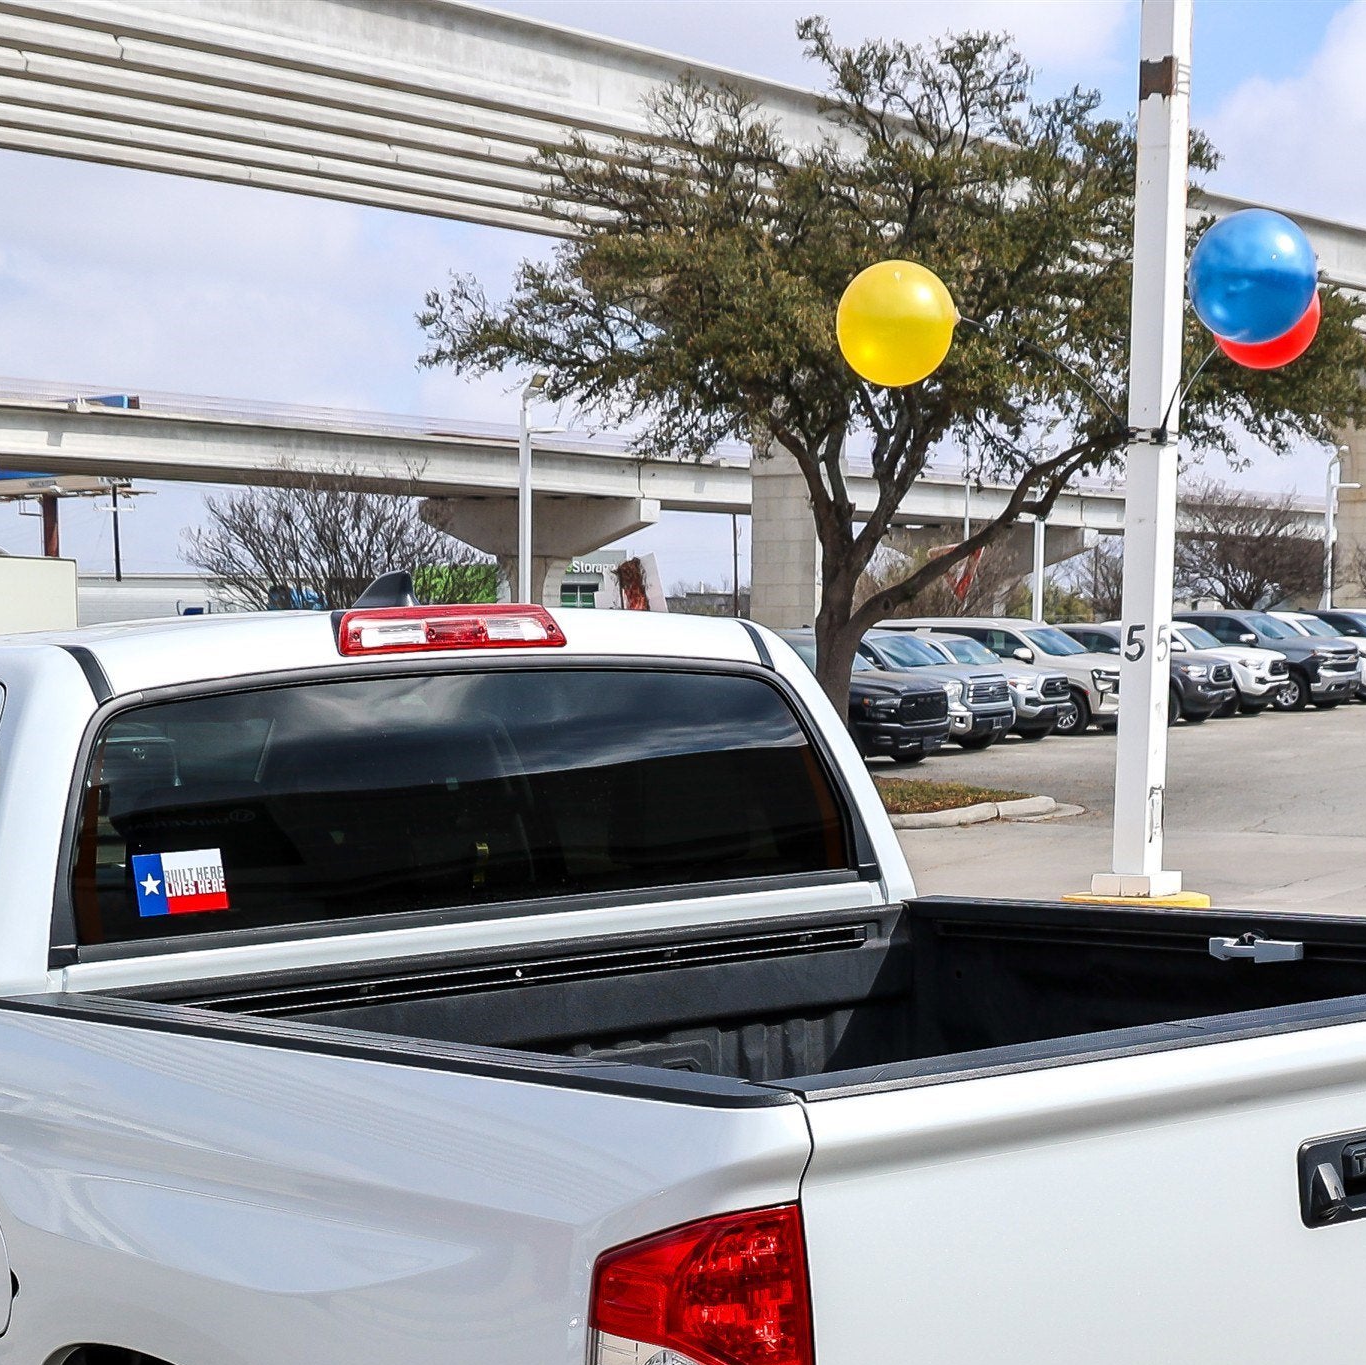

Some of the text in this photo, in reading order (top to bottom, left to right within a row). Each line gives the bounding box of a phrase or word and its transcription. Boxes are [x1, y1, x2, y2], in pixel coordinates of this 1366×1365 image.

[1124, 624, 1146, 662] 5
[1157, 624, 1168, 662] 5
[165, 865, 224, 883] BUILT HERE
[165, 879, 227, 898] LIVES HERE
